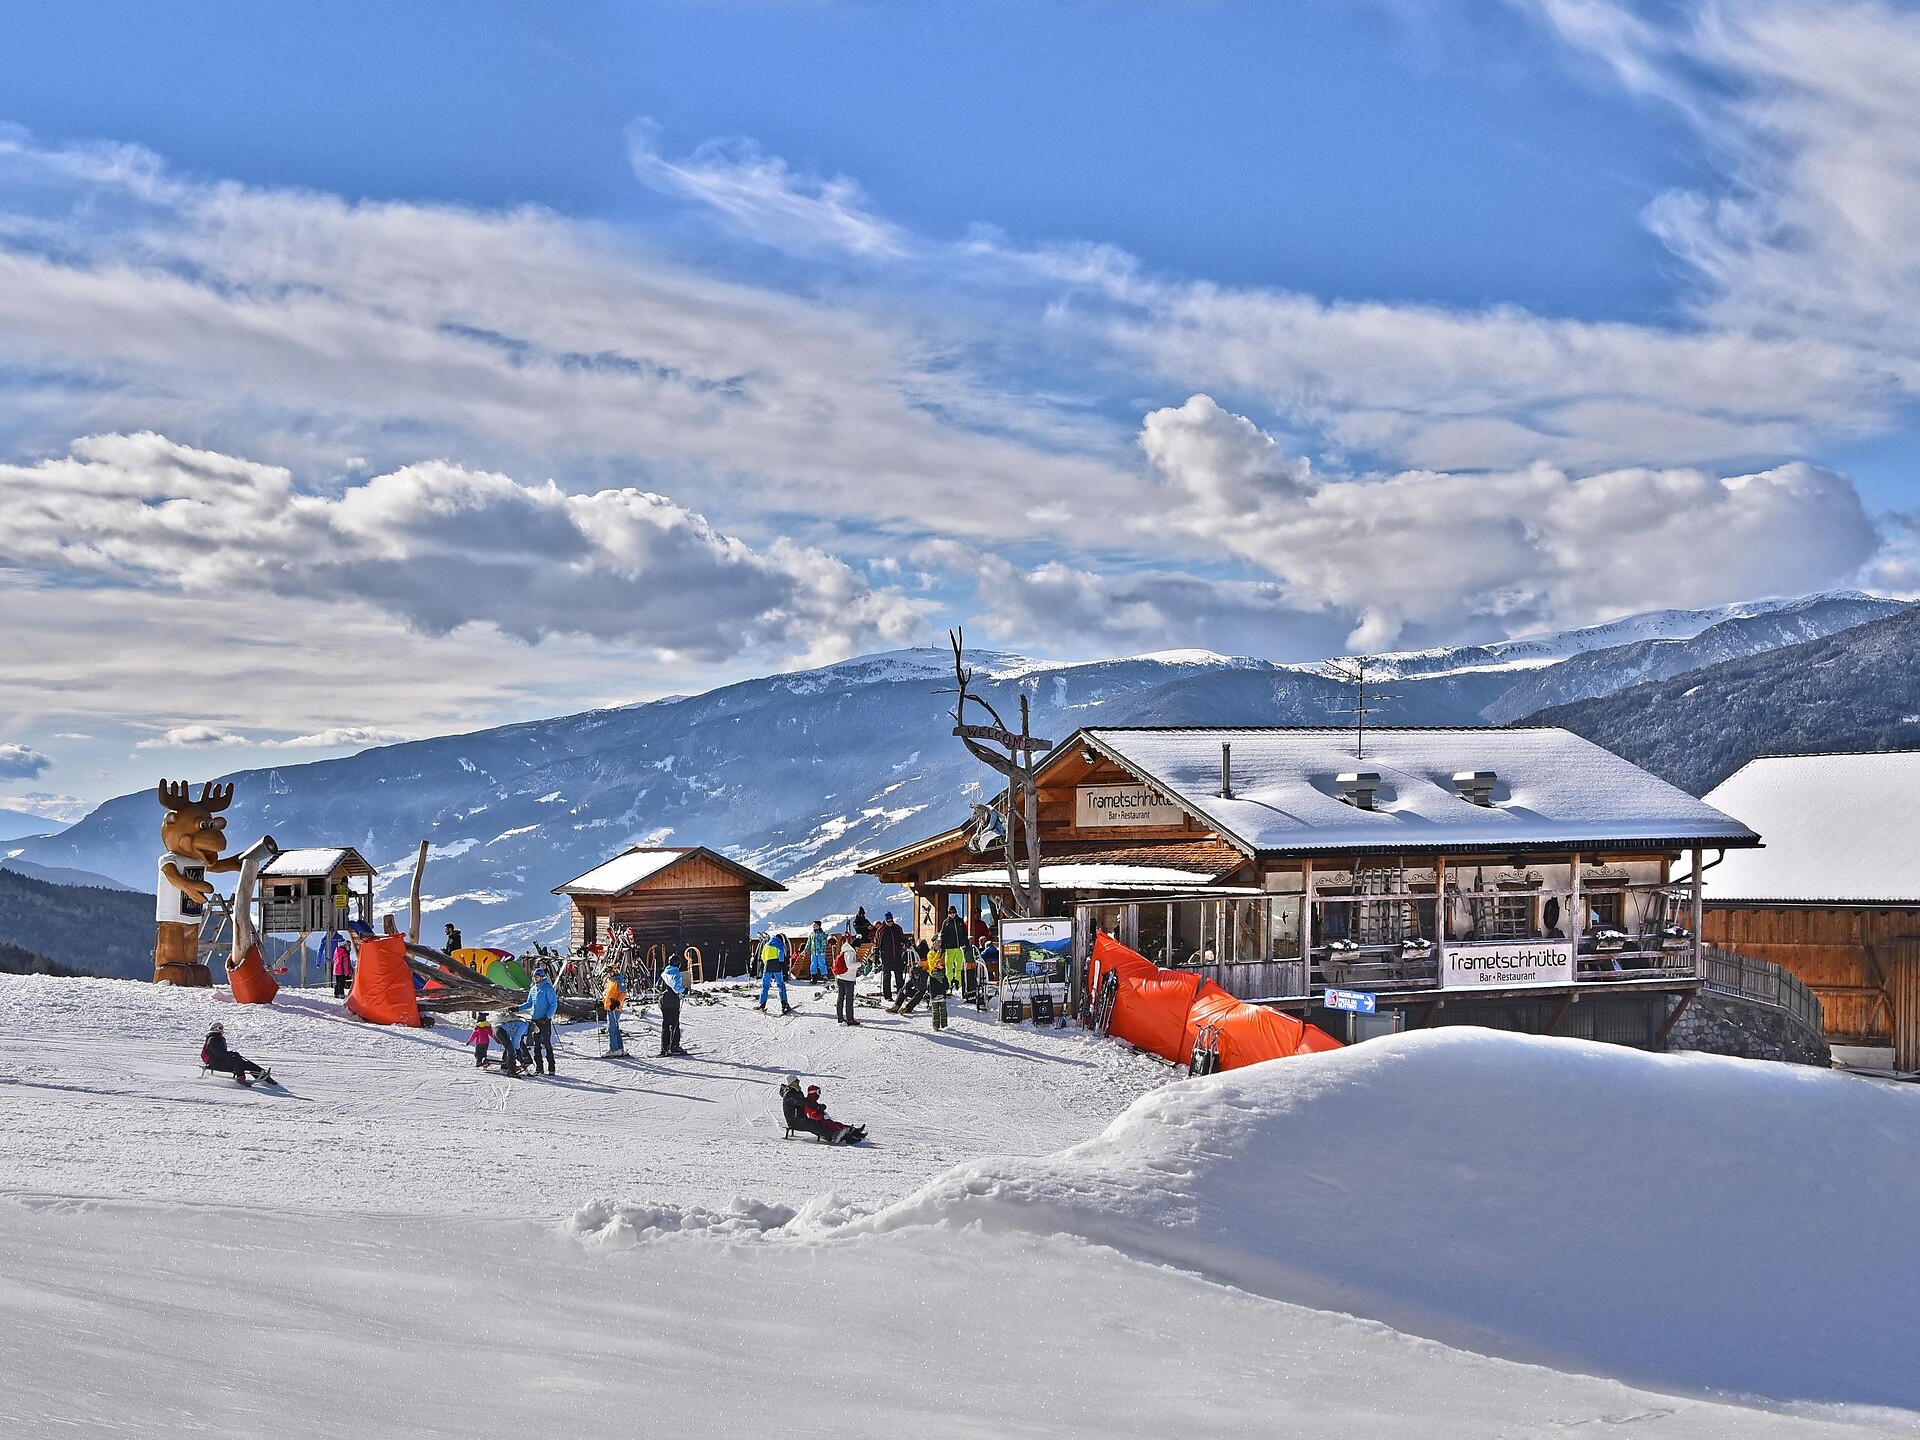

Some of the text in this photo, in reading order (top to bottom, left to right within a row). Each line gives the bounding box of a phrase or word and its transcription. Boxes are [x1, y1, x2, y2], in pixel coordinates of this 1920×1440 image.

[966, 726, 1032, 749] WELCOME
[1108, 810, 1151, 820] Bar Restaurant
[1449, 949, 1567, 971] Trametschhütte
[1479, 971, 1536, 982] Bar Restaurant
